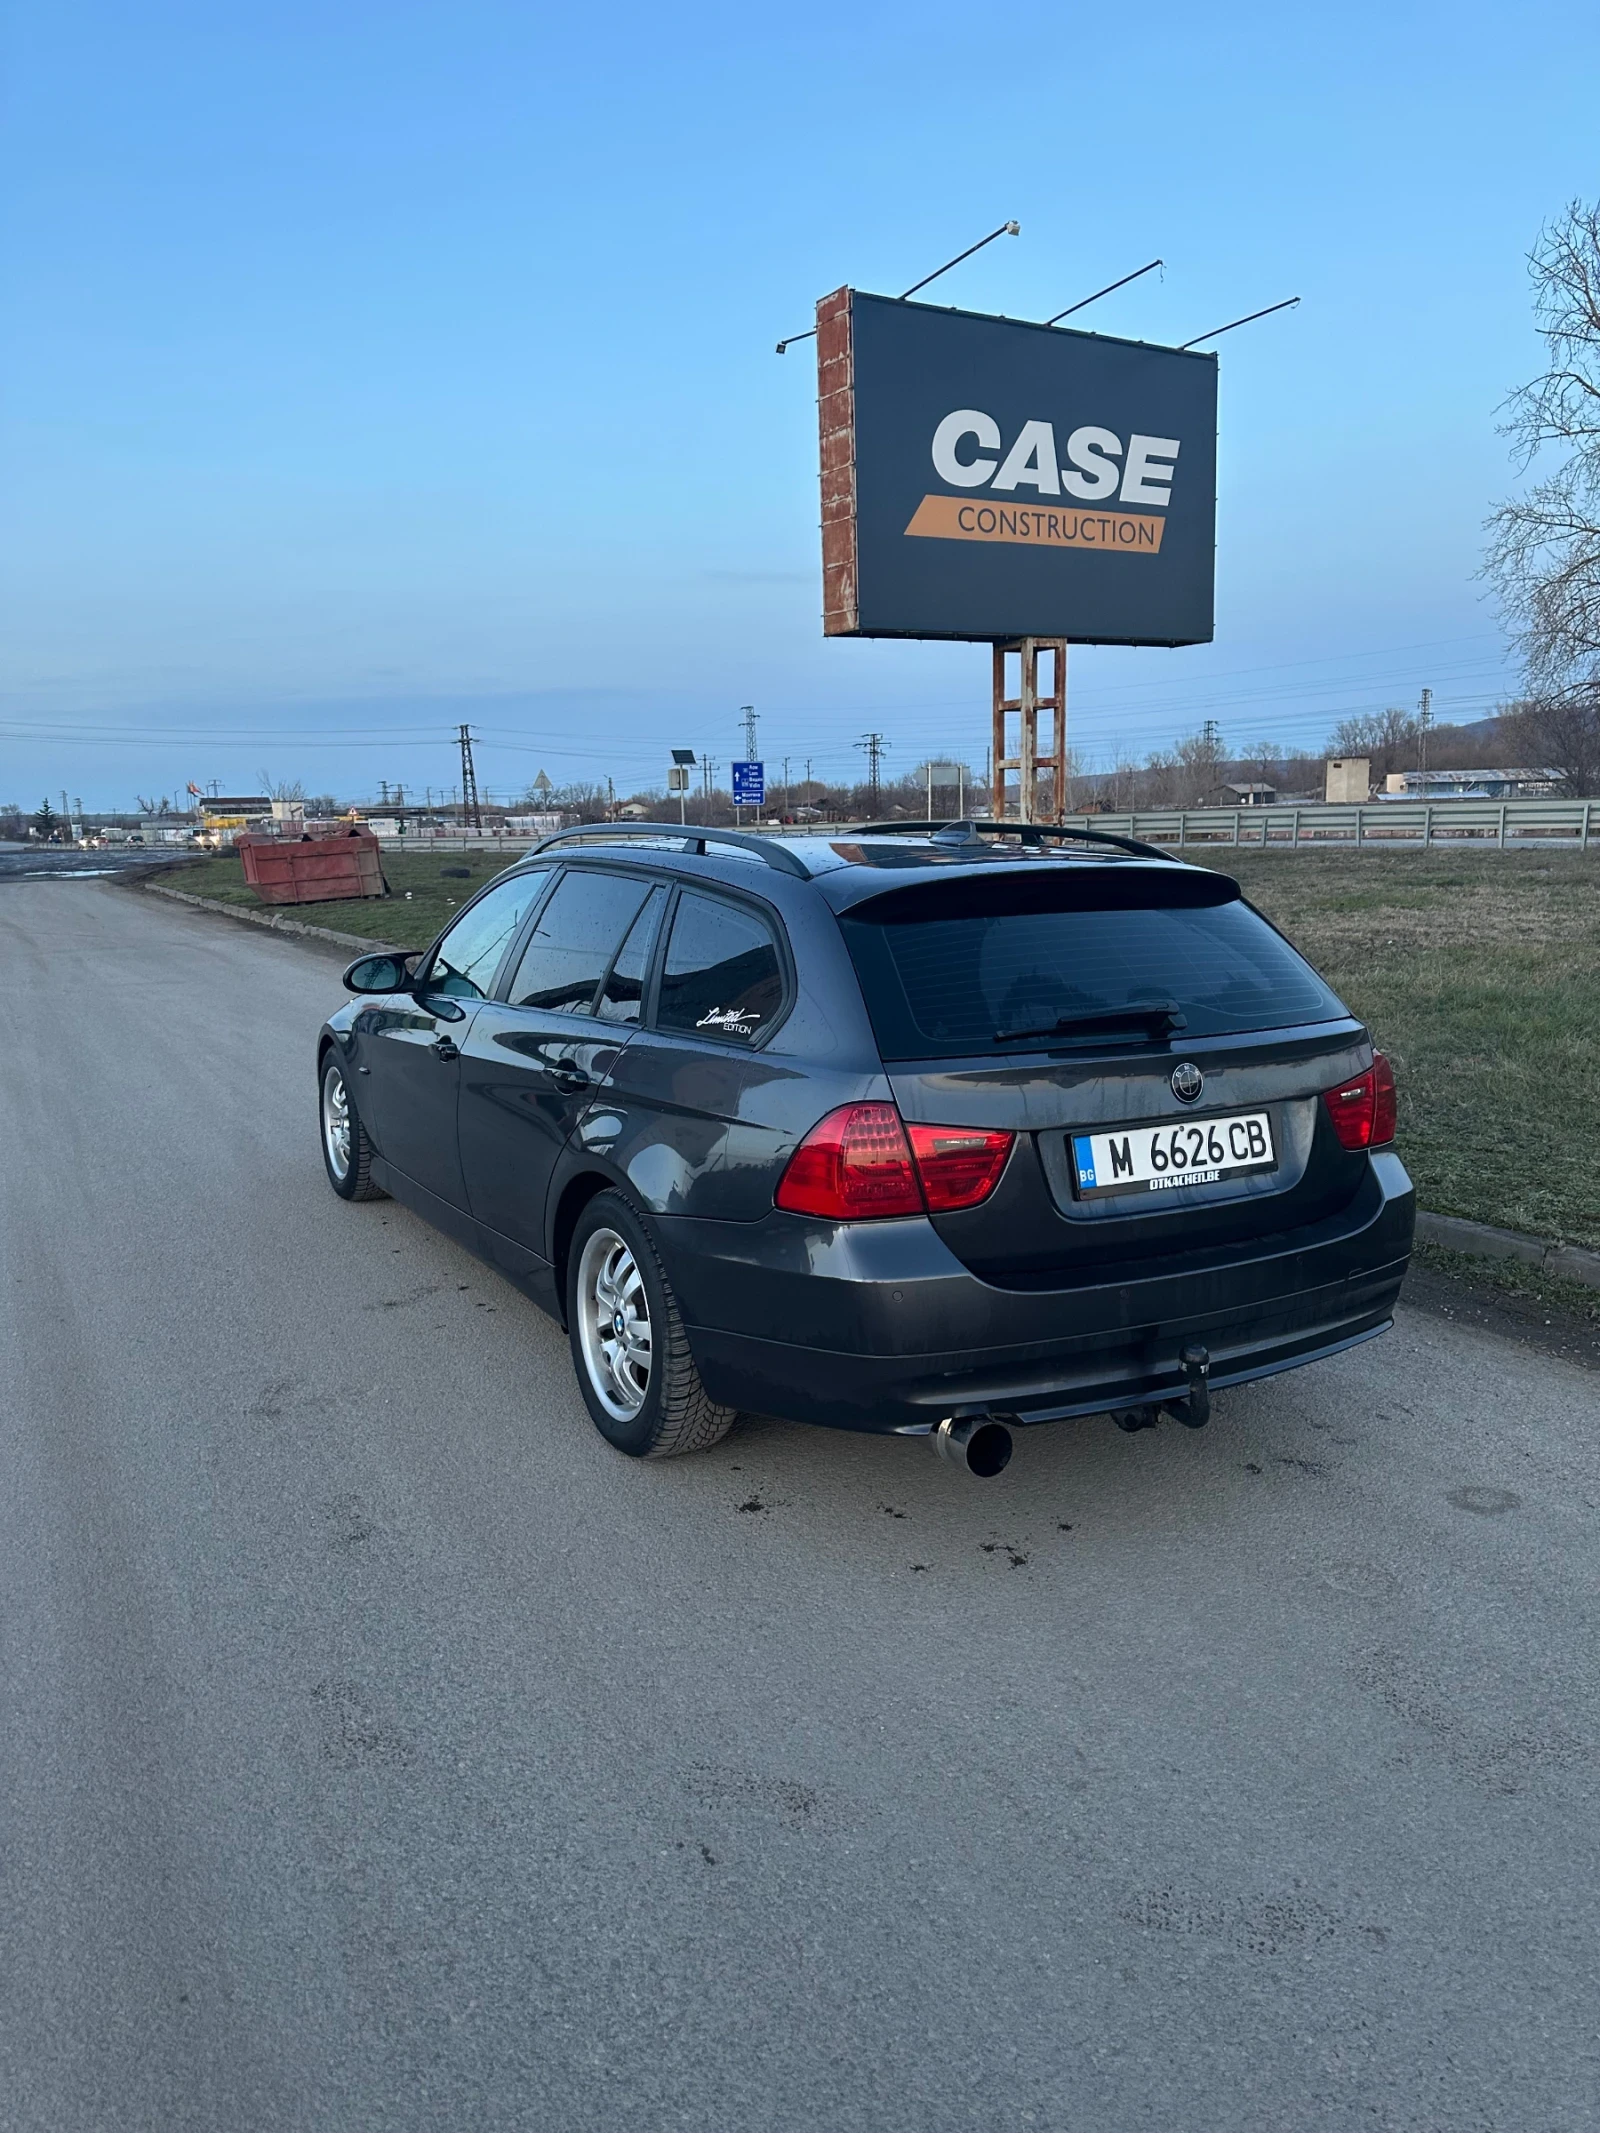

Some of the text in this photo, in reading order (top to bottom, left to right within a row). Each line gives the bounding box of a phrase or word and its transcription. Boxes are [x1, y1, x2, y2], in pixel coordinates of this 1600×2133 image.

[931, 409, 1181, 506] CASE
[958, 506, 1154, 546] CONSTRUCTION
[696, 1007, 760, 1027] Limited
[723, 1022, 751, 1034] EDITION
[1109, 1121, 1266, 1178] M 6626 CB
[1080, 1169, 1095, 1182] BG
